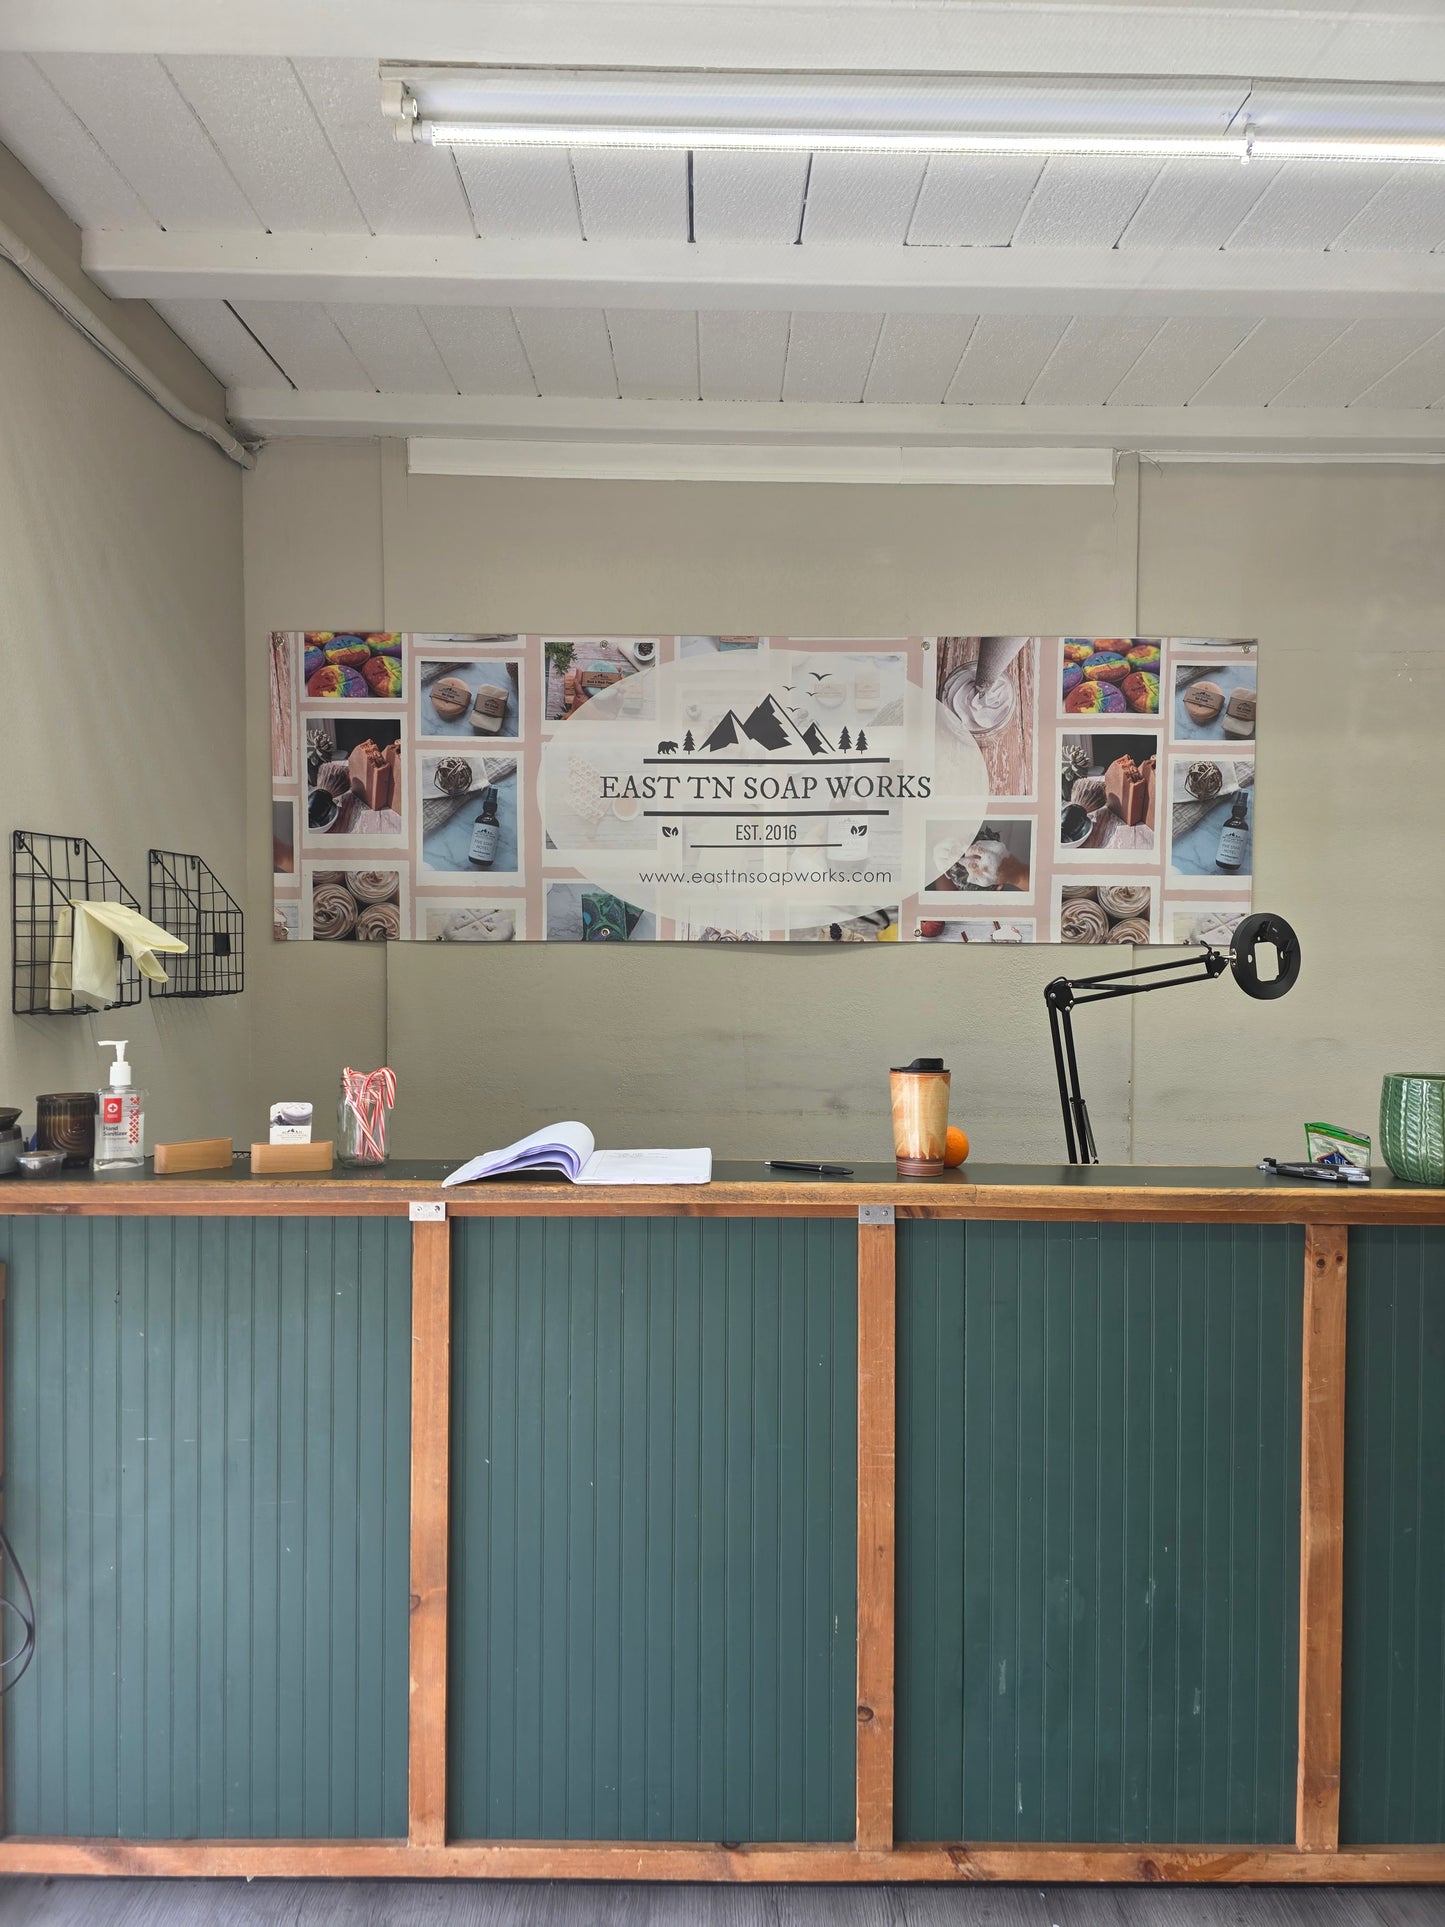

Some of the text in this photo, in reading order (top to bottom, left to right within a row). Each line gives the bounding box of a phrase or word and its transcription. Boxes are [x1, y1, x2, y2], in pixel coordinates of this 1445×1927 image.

[600, 774, 931, 800] EAST TN SOAP WORKS
[735, 824, 797, 841] EST. 2016
[638, 867, 892, 886] www.easttnsoapworks.com
